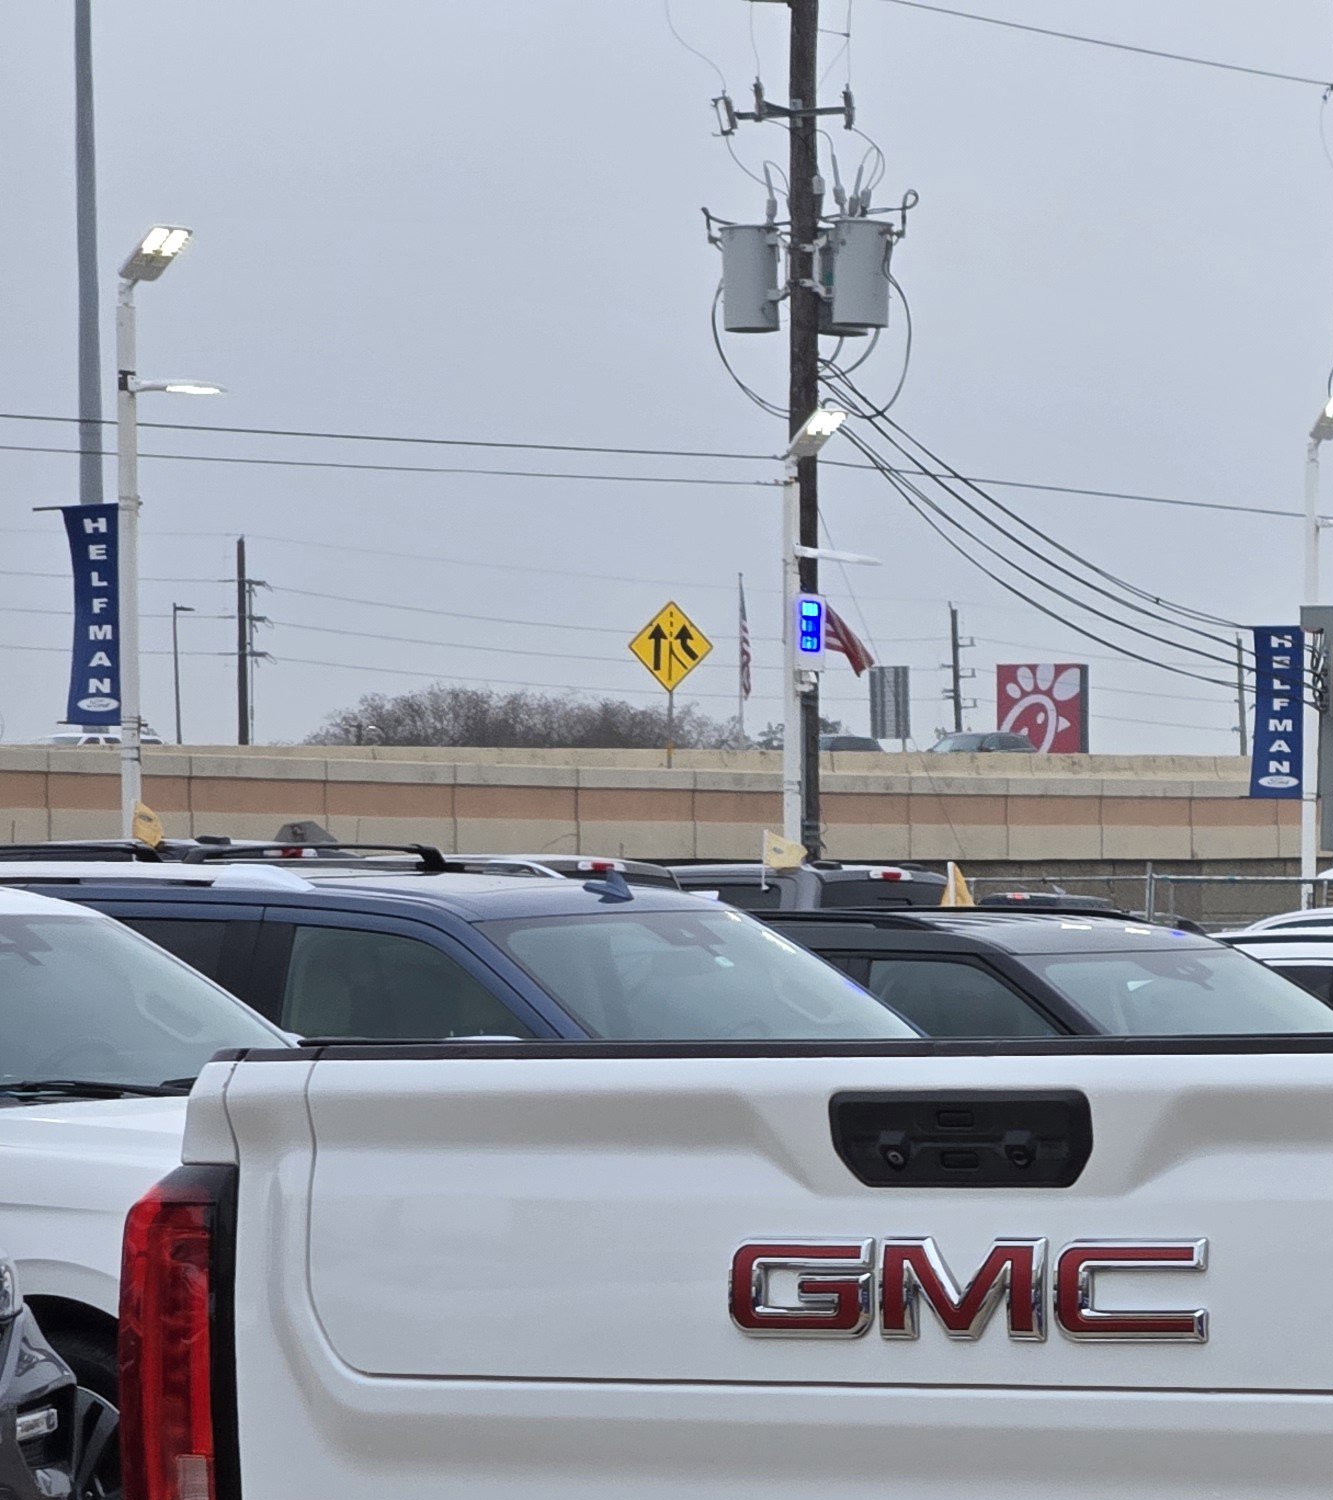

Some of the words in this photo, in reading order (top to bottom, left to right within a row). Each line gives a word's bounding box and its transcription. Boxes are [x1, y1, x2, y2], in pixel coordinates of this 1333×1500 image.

[83, 517, 112, 694] HELFMAN
[1268, 635, 1292, 774] HELFMAN
[729, 1236, 1209, 1342] GMC
